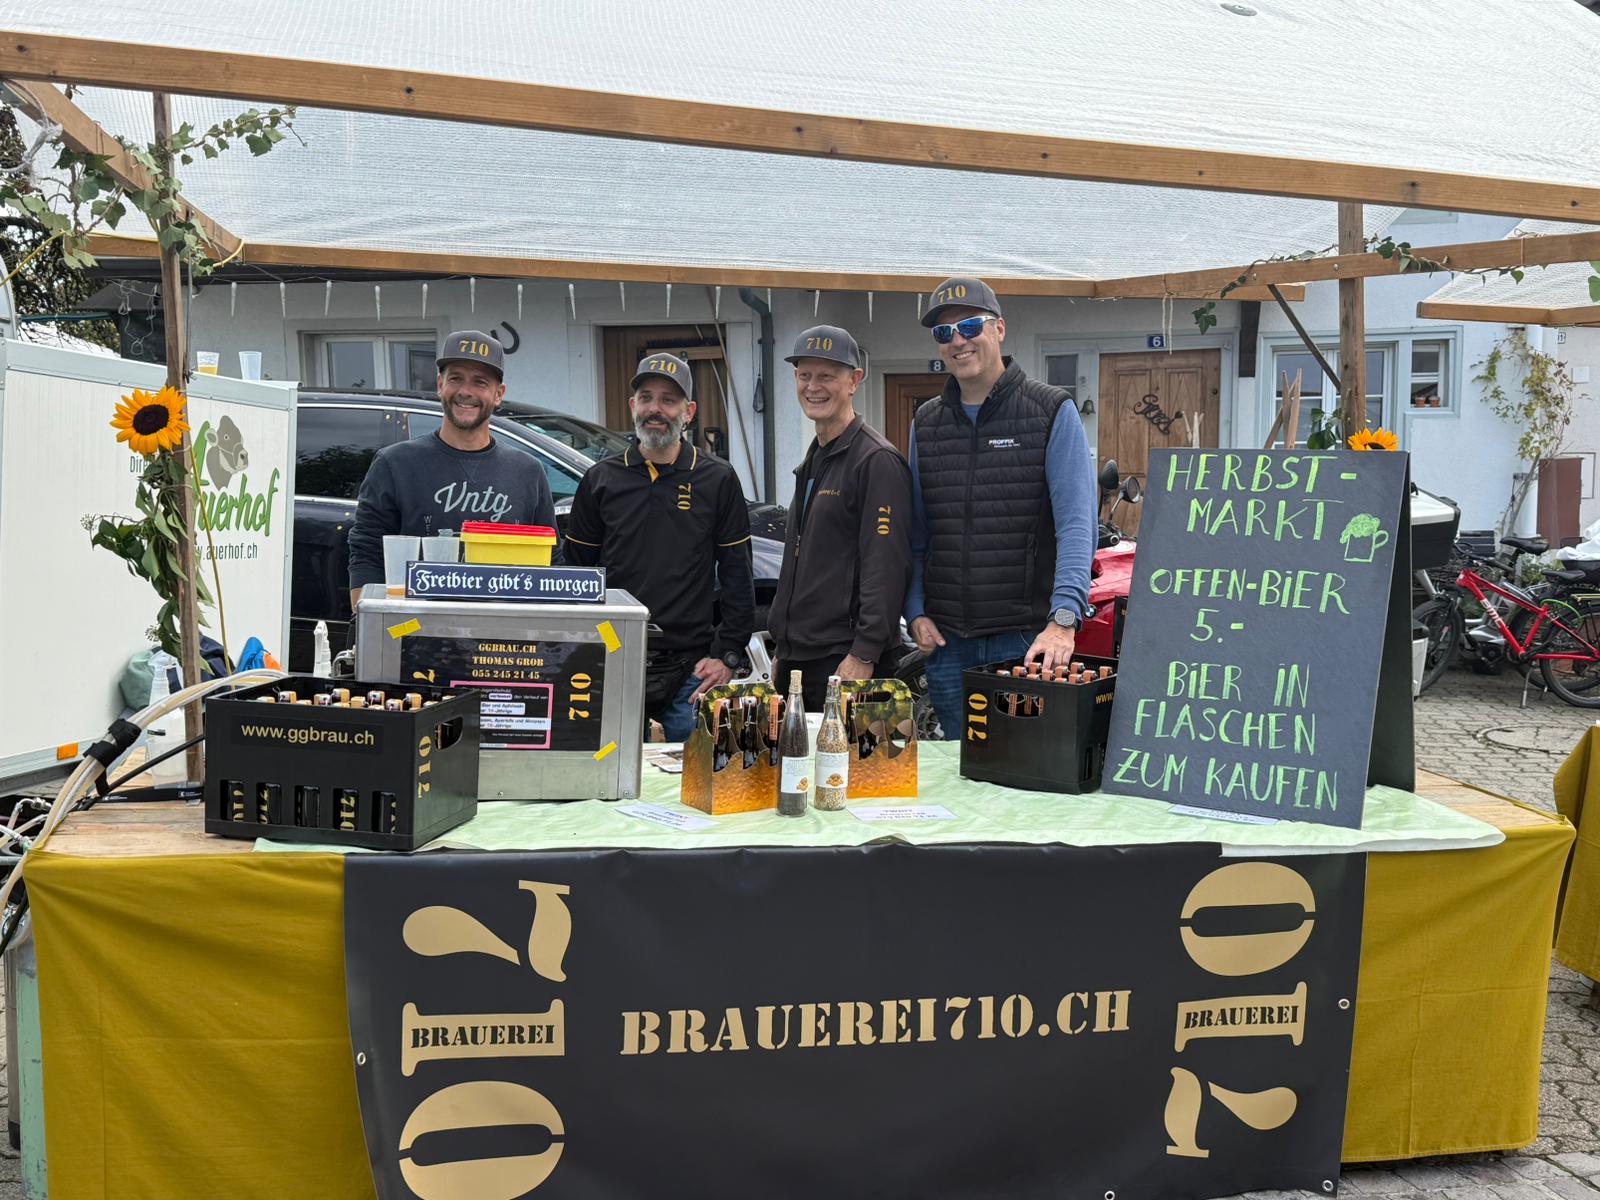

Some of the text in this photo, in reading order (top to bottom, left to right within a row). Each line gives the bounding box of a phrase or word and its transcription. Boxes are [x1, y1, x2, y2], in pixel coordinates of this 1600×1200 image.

[937, 285, 966, 303] 710
[459, 339, 489, 357] 710
[806, 337, 833, 352] 710
[1152, 336, 1162, 347] 6
[649, 359, 677, 374] 710
[933, 360, 942, 371] 8
[434, 481, 512, 522] Vntg
[677, 483, 692, 511] 710
[878, 505, 892, 535] 710
[1187, 498, 1344, 541] MARKT
[415, 569, 484, 592] Freibier
[539, 577, 600, 595] morgen
[1190, 608, 1244, 643] 5.-
[472, 656, 544, 667] THOMAS GROB
[478, 643, 537, 653] GGBRAU.CH
[472, 669, 540, 680] 055 245 21 45
[568, 673, 592, 720] 710
[967, 693, 988, 741] 710
[1134, 699, 1316, 756] FLASCHEN
[241, 725, 374, 745] www.ggbrau.ch
[417, 735, 432, 799] 710
[1112, 747, 1339, 812] ZUM KAUFEN
[620, 989, 1132, 1056] BRAUEREI710.CH
[1163, 861, 1317, 1158] 710
[1184, 1004, 1300, 1029] BRAUEREI
[399, 879, 572, 1200] 710
[411, 1024, 555, 1049] BRAUEREI
